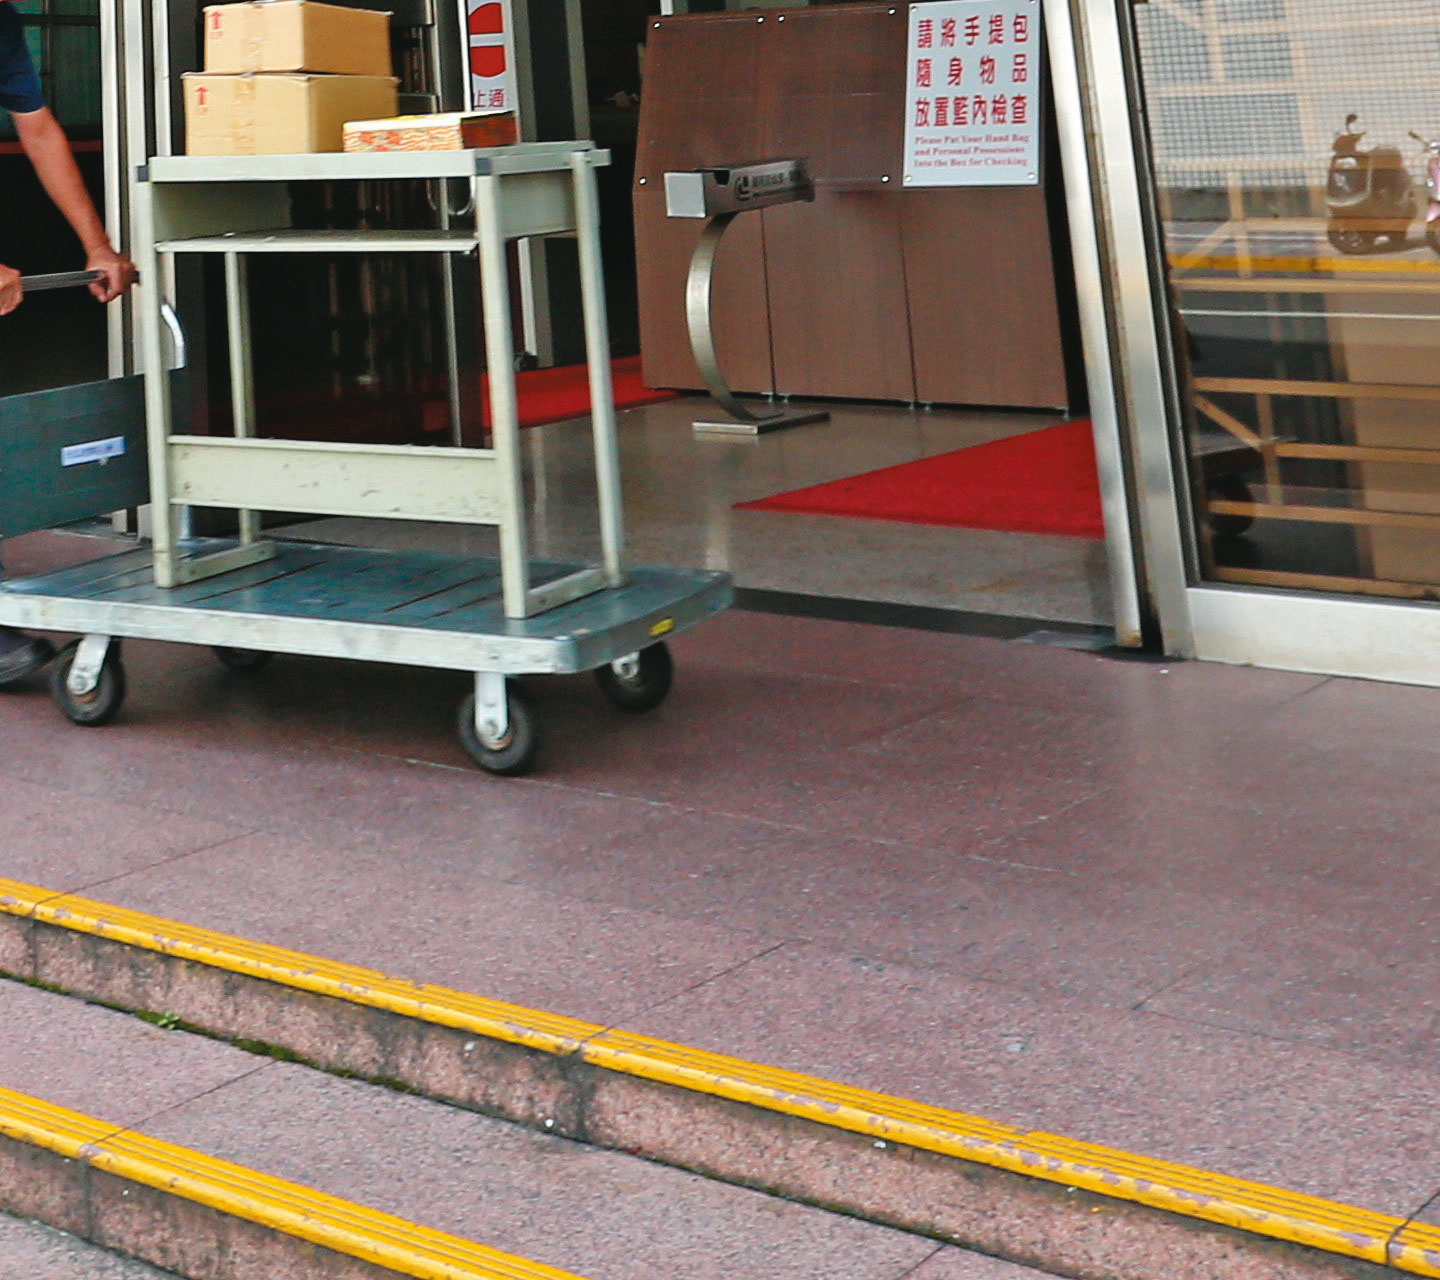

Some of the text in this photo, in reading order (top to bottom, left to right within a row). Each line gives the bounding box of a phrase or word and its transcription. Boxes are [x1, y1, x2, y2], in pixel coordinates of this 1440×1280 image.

[917, 13, 1029, 49] 請將手提包
[916, 53, 1028, 88] 隨身物品
